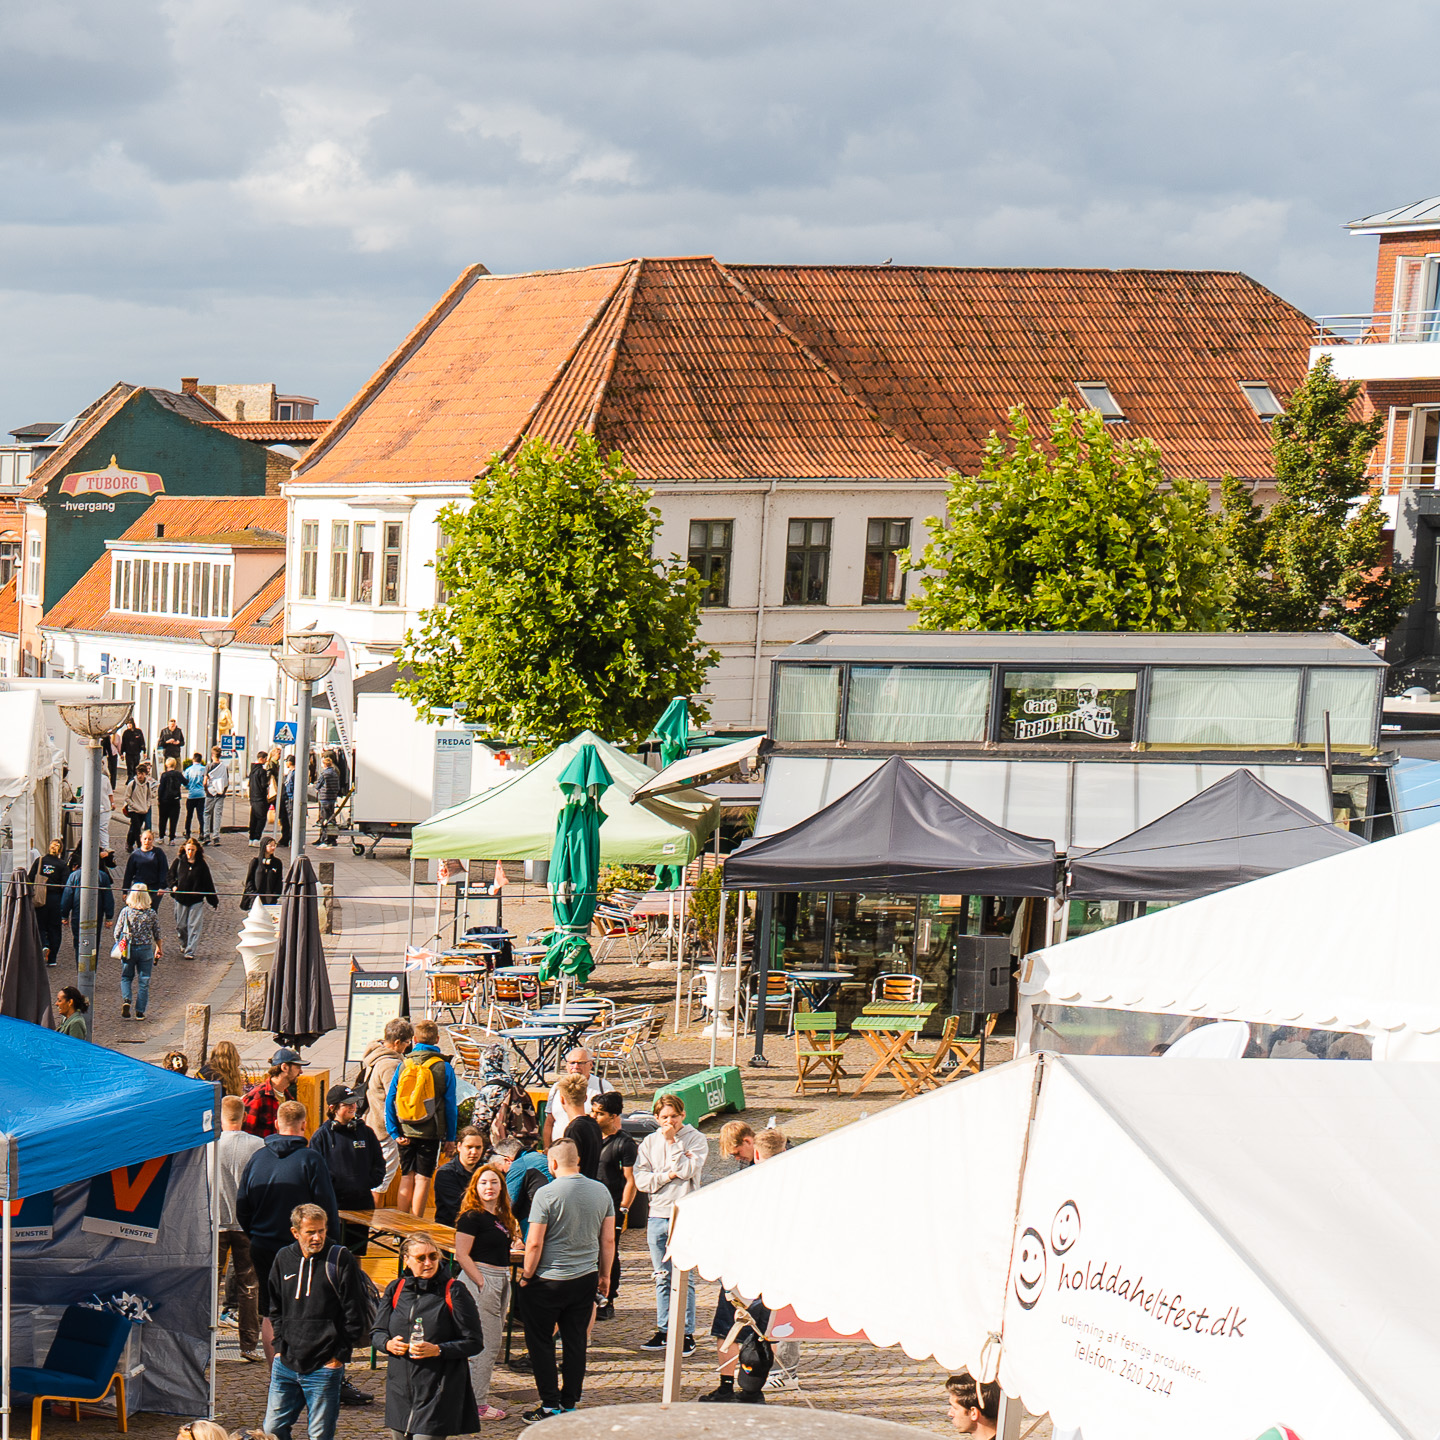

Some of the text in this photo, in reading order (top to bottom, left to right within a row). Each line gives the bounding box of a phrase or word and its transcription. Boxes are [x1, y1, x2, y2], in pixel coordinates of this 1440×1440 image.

[86, 477, 138, 490] TUBORG
[1023, 699, 1058, 714] Café
[1093, 720, 1115, 735] VII
[437, 738, 471, 746] FREDAG
[355, 979, 389, 988] TUBORG
[15, 1229, 49, 1239] VENSTRE
[119, 1226, 153, 1239] VENSTRE
[1058, 1260, 1247, 1338] holddaheltfest.dk
[1061, 1313, 1105, 1343] udlejning
[1106, 1331, 1119, 1345] af
[1073, 1340, 1117, 1374] Telefon:
[1119, 1359, 1144, 1386] 2620
